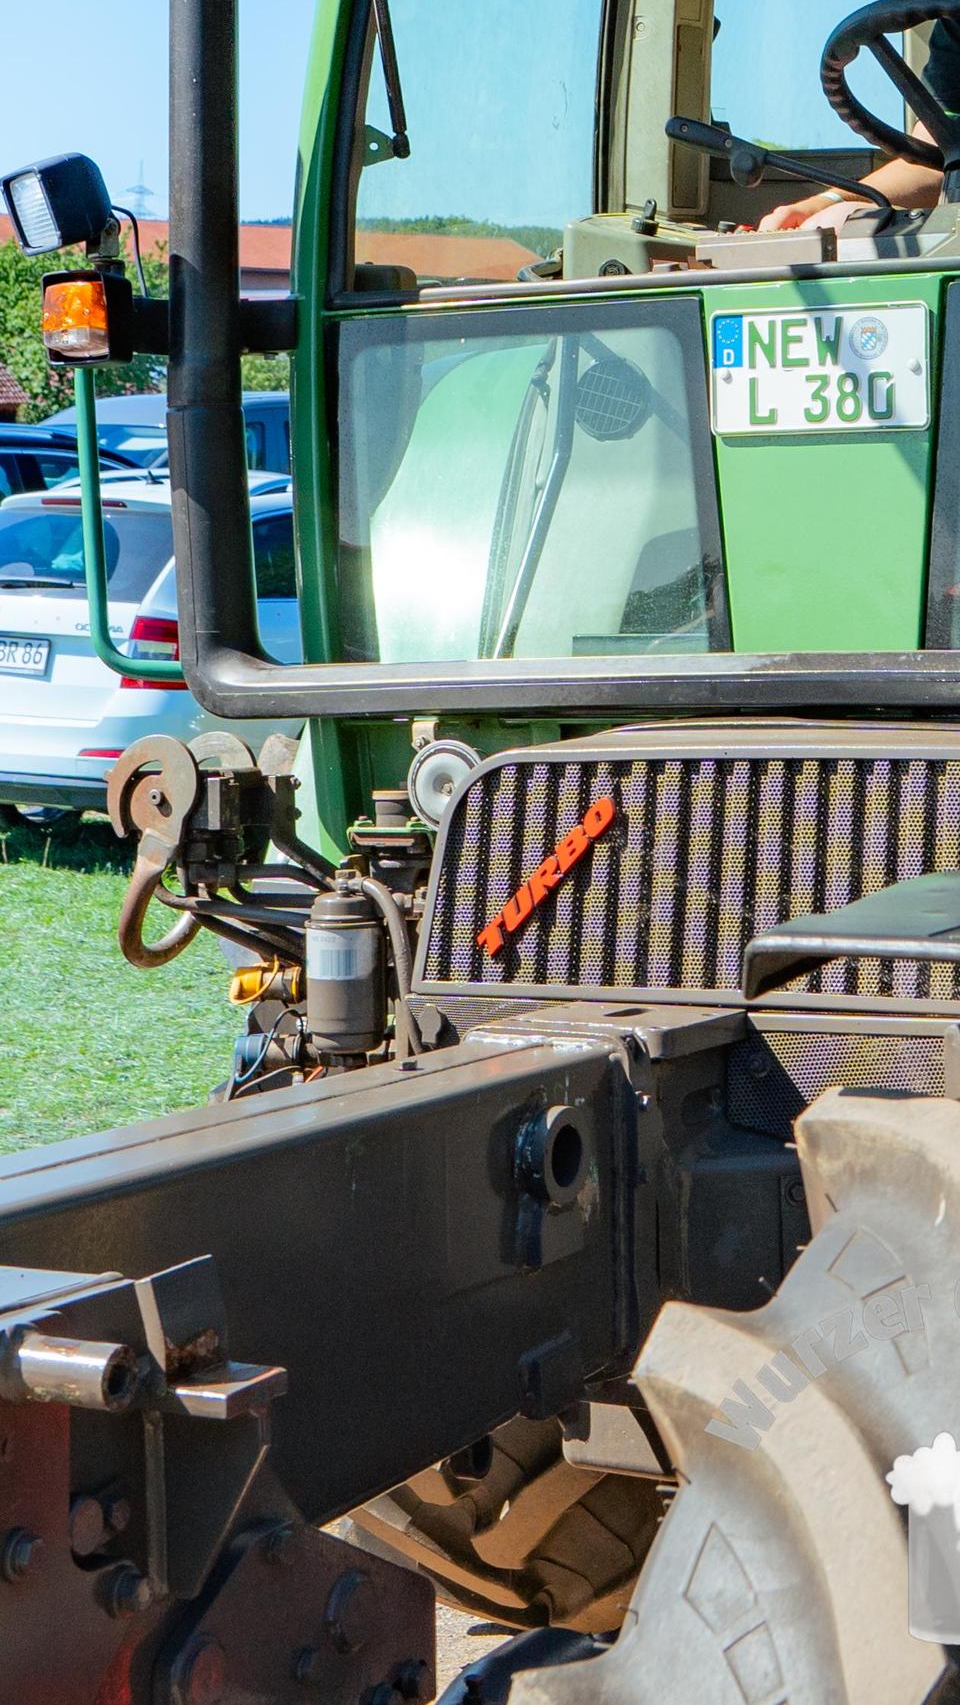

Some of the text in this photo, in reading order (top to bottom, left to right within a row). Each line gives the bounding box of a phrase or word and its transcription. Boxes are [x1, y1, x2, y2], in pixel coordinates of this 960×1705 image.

[722, 348, 736, 366] D
[747, 316, 842, 369] NEW
[748, 371, 896, 425] L 380
[22, 642, 43, 665] 86
[476, 796, 616, 958] TURBO
